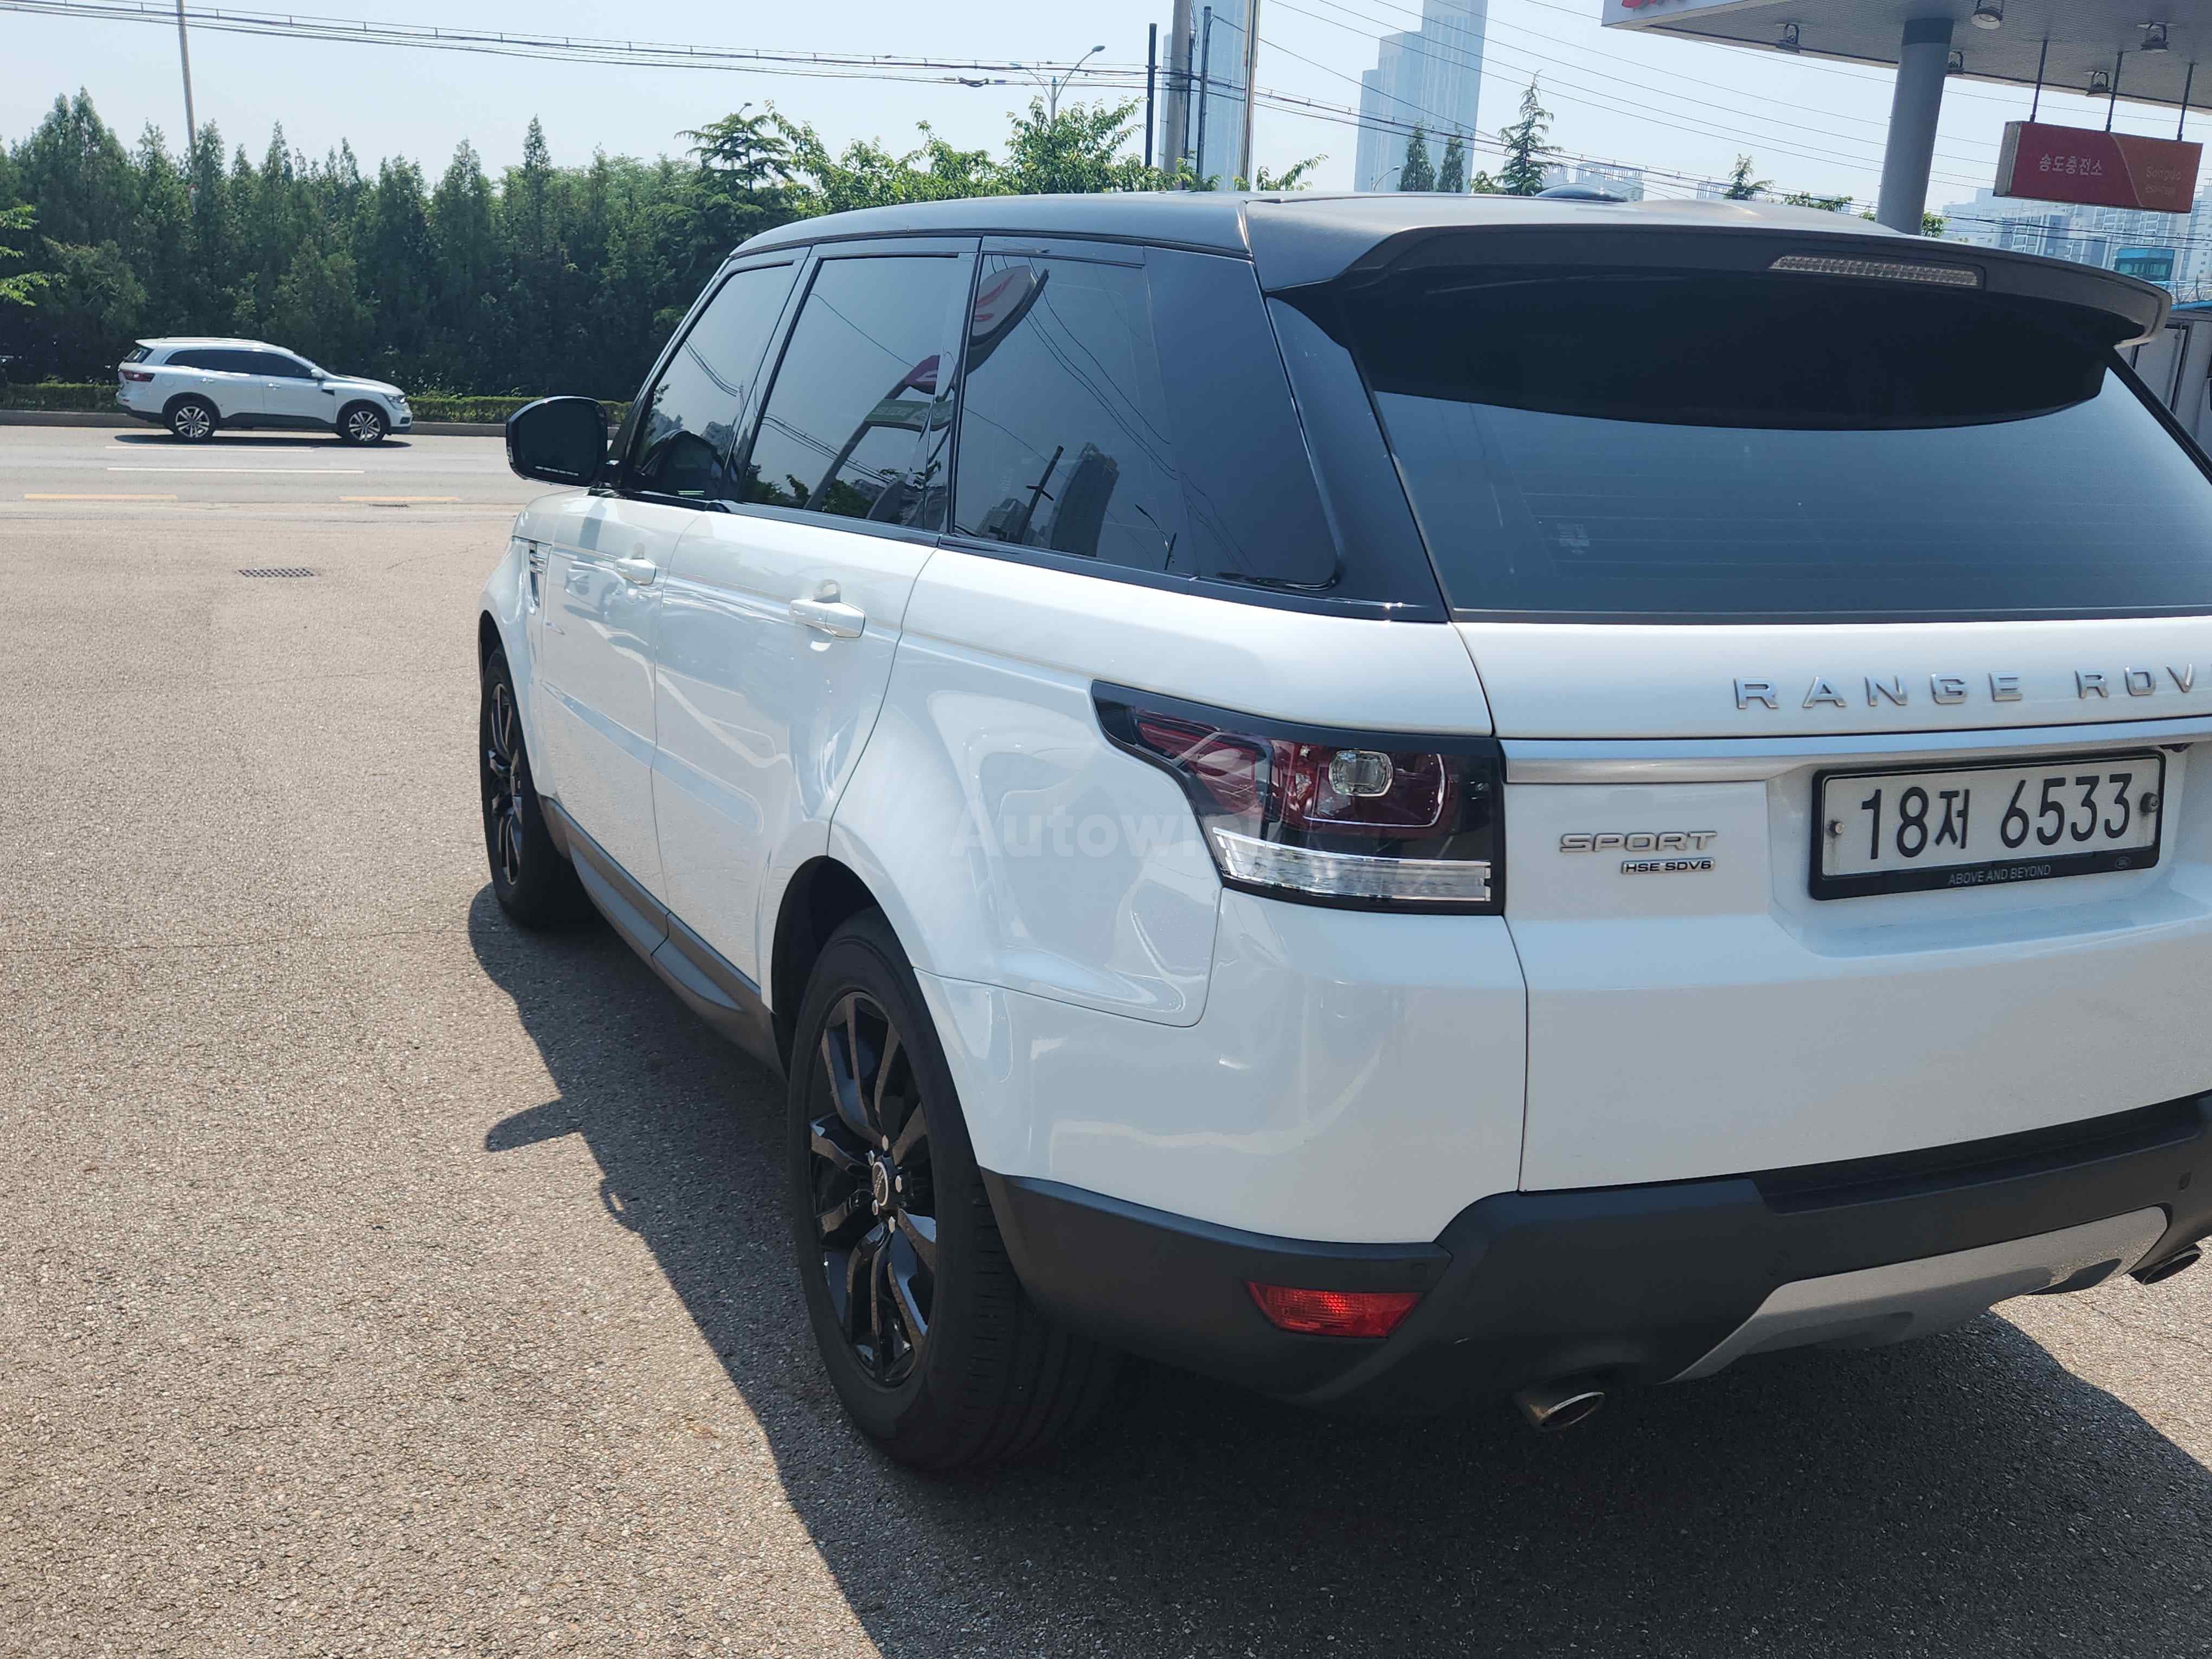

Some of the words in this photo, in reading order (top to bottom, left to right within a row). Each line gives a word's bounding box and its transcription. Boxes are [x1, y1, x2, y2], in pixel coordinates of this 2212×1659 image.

[2039, 153, 2104, 176] 송도충전소
[1734, 672, 2023, 709] RANGE
[2075, 663, 2212, 699] ROV
[1861, 787, 1970, 859] 18저
[2001, 773, 2132, 848] 6533
[1560, 831, 1718, 853] SPORT
[1626, 863, 1660, 872] HSE
[1664, 860, 1712, 871] SDV6
[1949, 871, 1984, 885] ABOVE
[1985, 868, 2008, 882] AND
[2010, 864, 2052, 879] BEYOND
